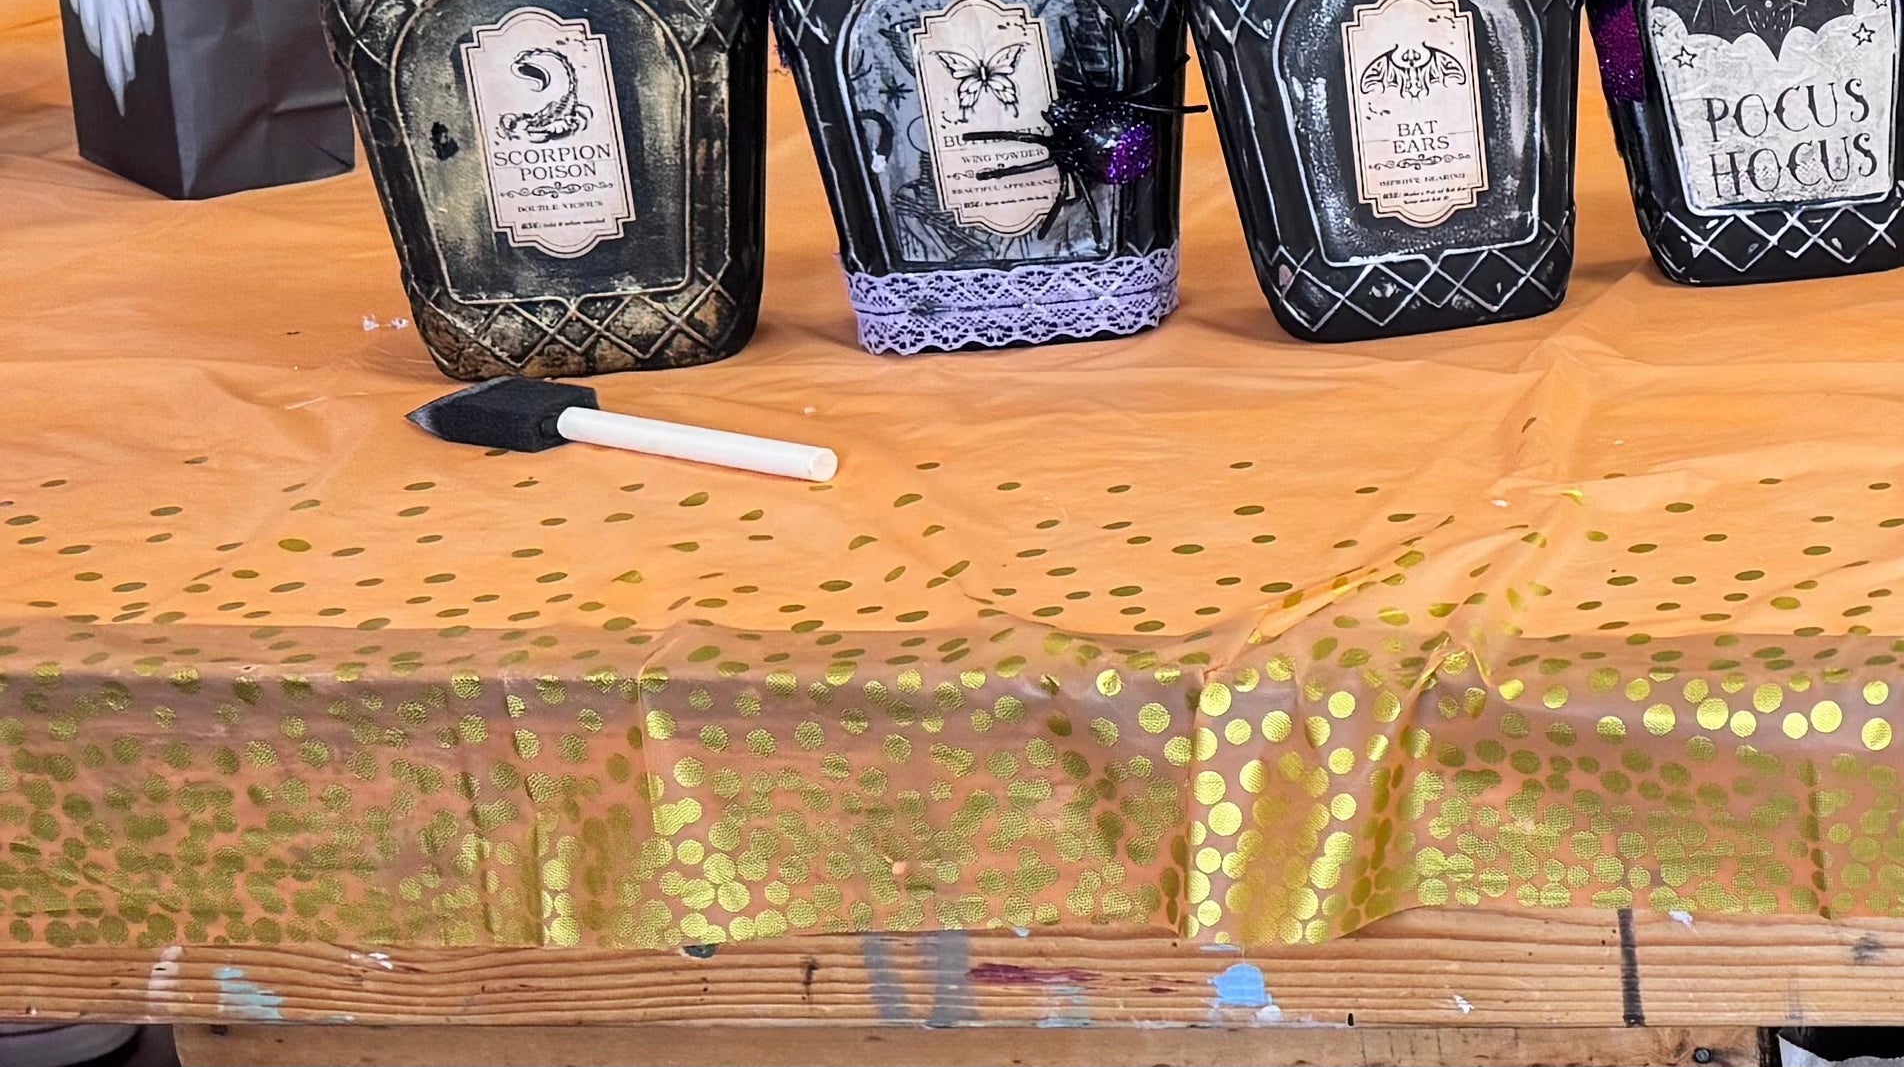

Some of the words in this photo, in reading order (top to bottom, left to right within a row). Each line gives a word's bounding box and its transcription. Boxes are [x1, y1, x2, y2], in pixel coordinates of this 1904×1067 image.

[1702, 77, 1870, 142] POCUS
[1397, 120, 1438, 137] BAT
[1392, 135, 1450, 154] EARS
[494, 143, 612, 166] SCORPION
[961, 155, 992, 163] WING
[995, 148, 1045, 161] POWDER
[520, 162, 597, 181] POISON
[1709, 132, 1877, 198] HOCUS
